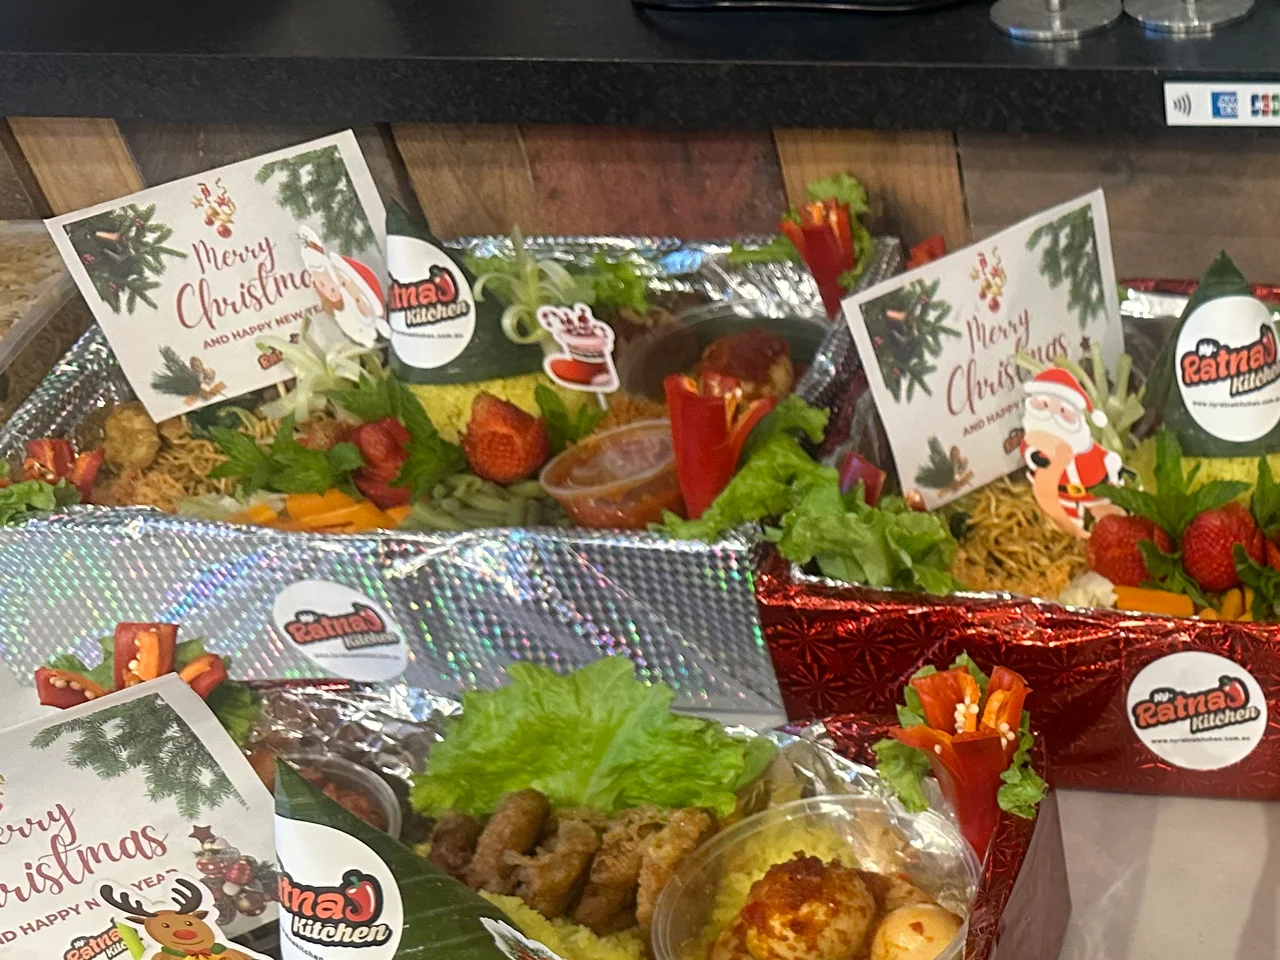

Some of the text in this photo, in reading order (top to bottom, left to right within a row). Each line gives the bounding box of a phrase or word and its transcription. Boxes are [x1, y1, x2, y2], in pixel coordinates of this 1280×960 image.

[192, 236, 277, 275] Merry
[176, 262, 313, 330] Christma
[406, 301, 467, 325] Kitchen
[203, 334, 230, 350] AND
[231, 320, 272, 340] HAPPY
[274, 311, 304, 326] NEW
[966, 308, 1030, 354] Merry
[1182, 344, 1264, 384] Ratna
[963, 418, 985, 438] AND
[986, 401, 1020, 425] HAPPY
[287, 615, 368, 643] Ratna
[1136, 691, 1226, 727] Ratna
[1191, 707, 1258, 731] Kitchen
[19, 904, 81, 935] HAPPY
[130, 868, 178, 891] YEA
[293, 915, 389, 943] Kitchen
